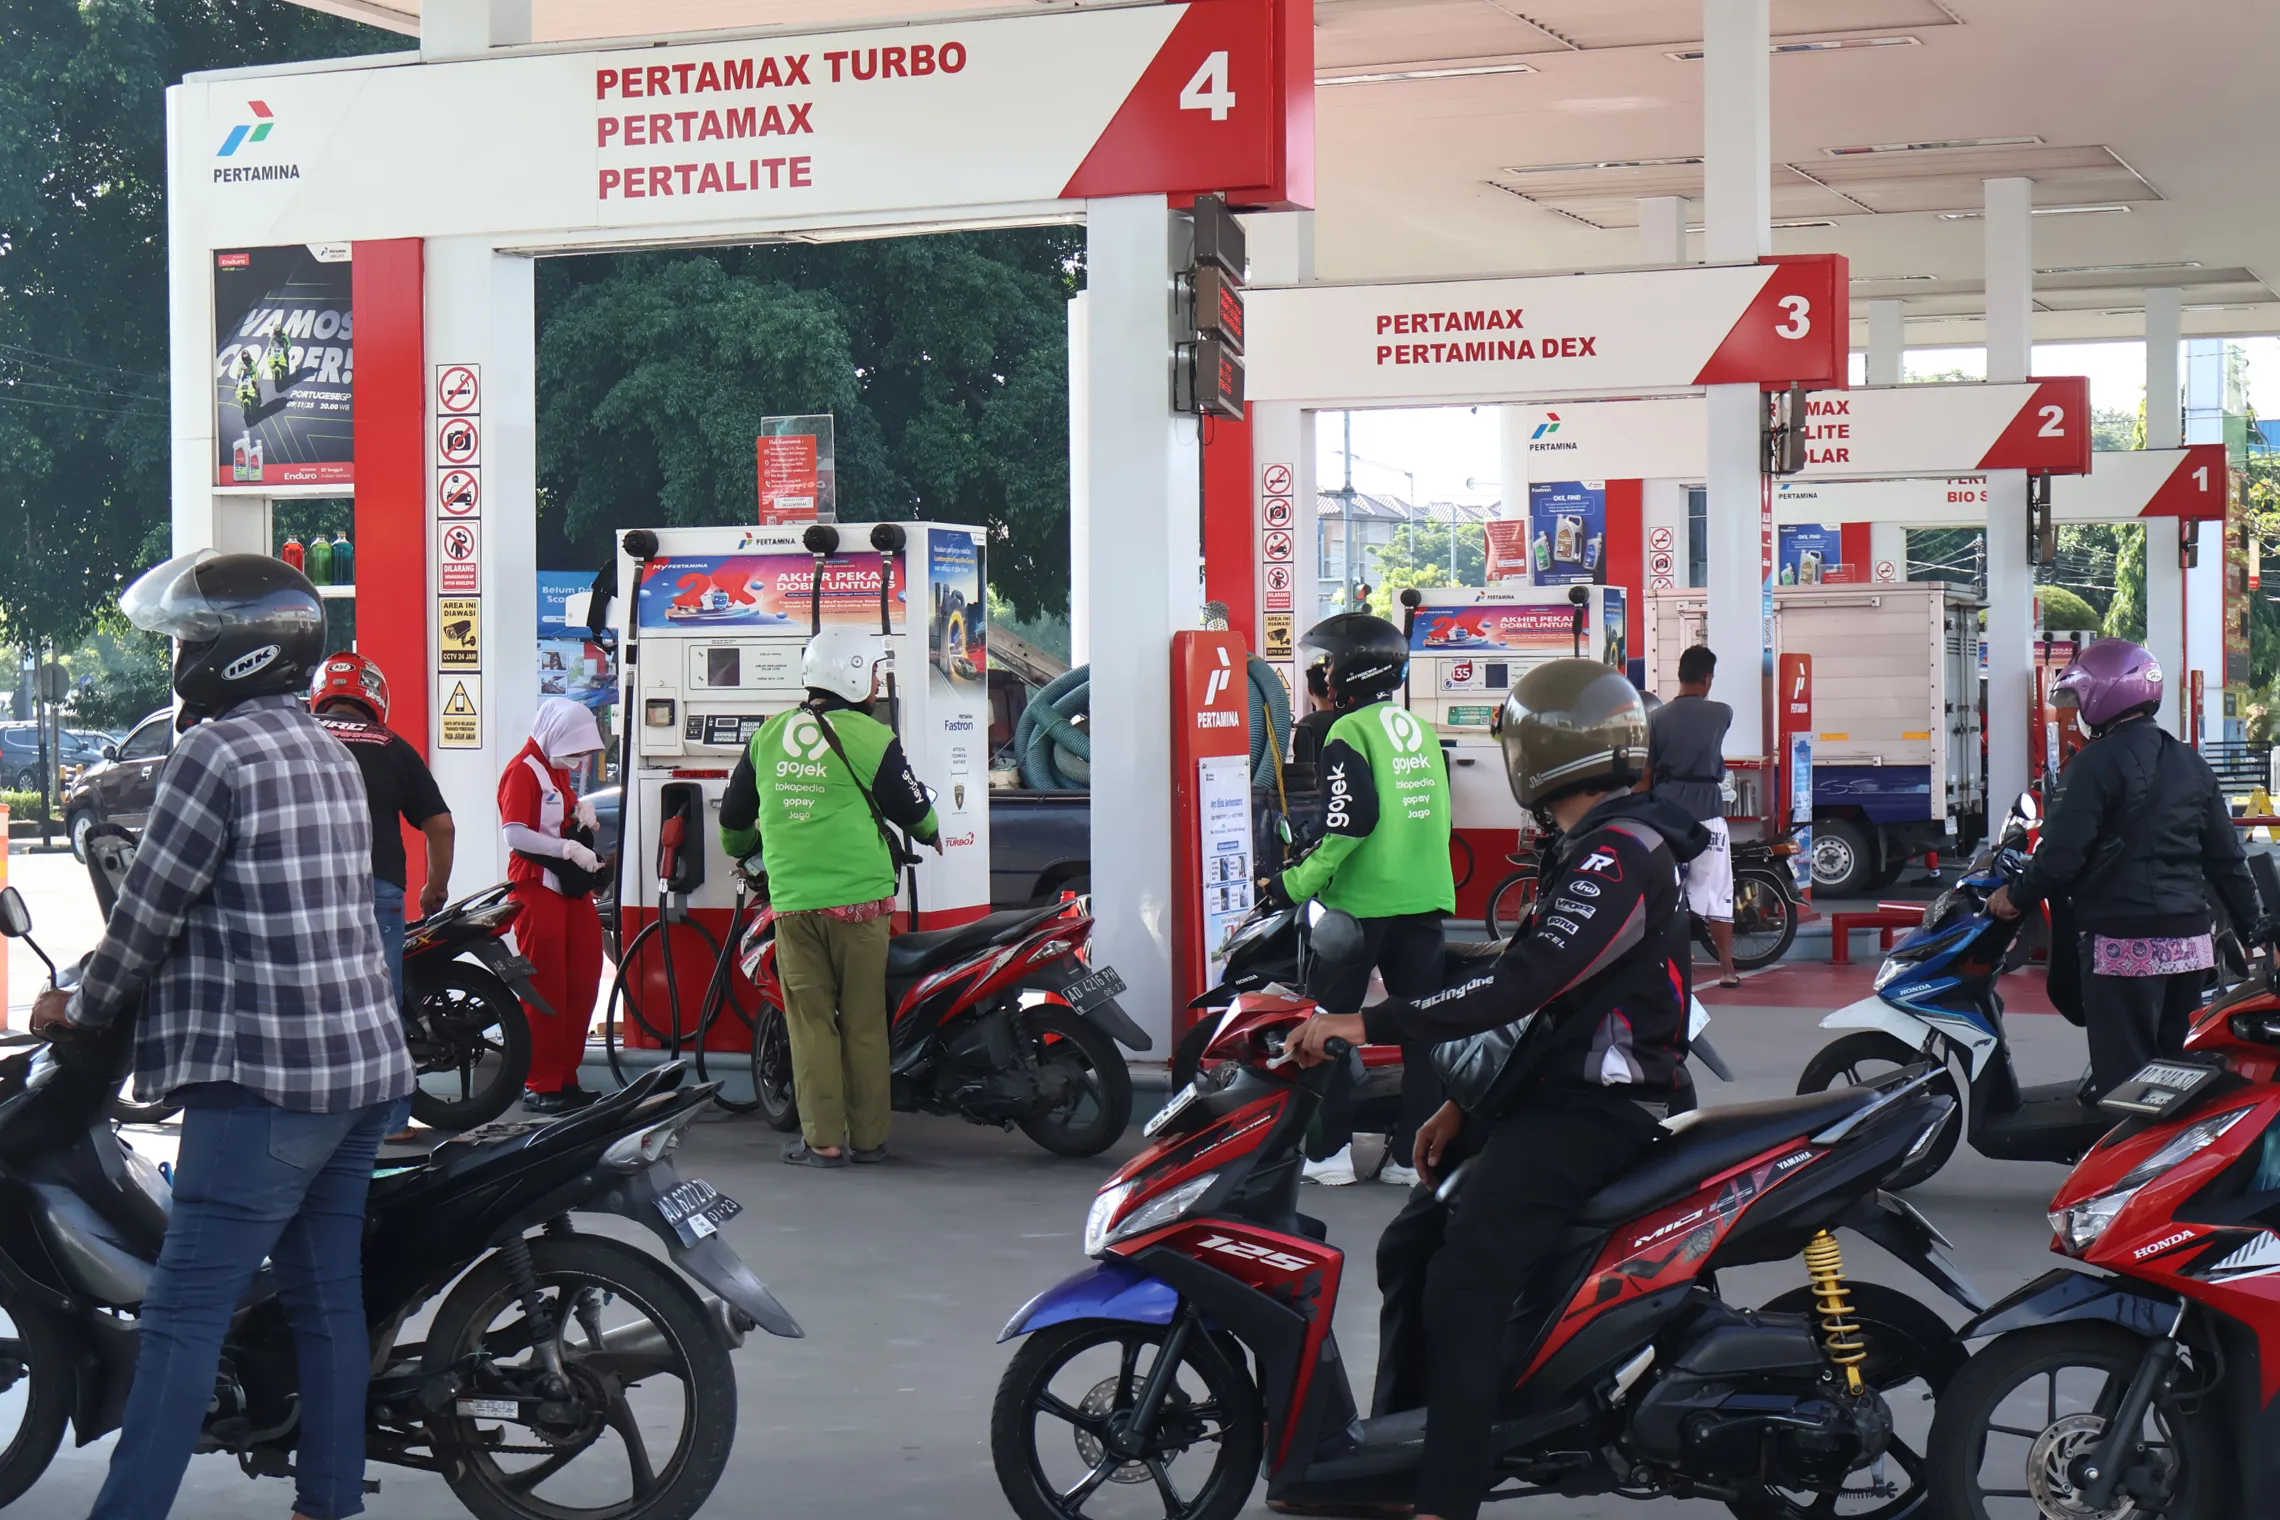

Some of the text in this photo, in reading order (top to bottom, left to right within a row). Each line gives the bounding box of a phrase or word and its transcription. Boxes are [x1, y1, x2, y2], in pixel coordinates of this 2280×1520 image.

[596, 41, 967, 100] PERTAMAX TURBO
[1180, 51, 1236, 121] 4
[598, 102, 814, 148] PERTAMAX
[213, 164, 300, 184] PERTAMINA
[598, 156, 812, 200] PERTALITE
[1376, 309, 1524, 335] PERTAMAX
[1775, 295, 1811, 339] 3
[1376, 336, 1597, 365] PERTAMINA DEX
[2037, 405, 2064, 438] 2
[1529, 442, 1578, 451] PERTAMINA
[284, 472, 317, 480] Enduro
[2191, 466, 2208, 492] 1
[1778, 492, 1818, 500] PERTAMINA
[1947, 491, 1976, 503] BIO
[756, 538, 796, 546] PERTAMINA
[443, 564, 475, 573] DILARANG
[776, 572, 832, 583] AKHR
[542, 586, 575, 594] Belum
[230, 648, 271, 677] INK
[944, 720, 974, 731] Fastron
[1197, 711, 1240, 729] PERTAMINA
[776, 760, 827, 778] gojek
[1392, 752, 1431, 776] gojek
[775, 782, 825, 793] tokopedia
[901, 769, 925, 804] gopay
[1395, 778, 1435, 790] tokopedia
[783, 798, 815, 808] gopay
[1326, 761, 1353, 828] gojek
[1402, 793, 1431, 806] gopay
[788, 811, 811, 820] Jago
[1407, 808, 1431, 819] Jago
[945, 838, 970, 847] TURBO
[1580, 853, 1615, 872] R
[1575, 882, 1597, 894] Arai
[1067, 967, 1118, 1003] AD 4216 PH
[1900, 983, 1932, 996] HONDA
[1776, 1151, 1812, 1170] YAMAHA
[659, 1196, 683, 1223] AD
[671, 1182, 707, 1213] 6272
[1634, 1186, 1754, 1248] MIO 125
[1197, 1234, 1316, 1272] 125
[2132, 1228, 2196, 1260] HONDA
